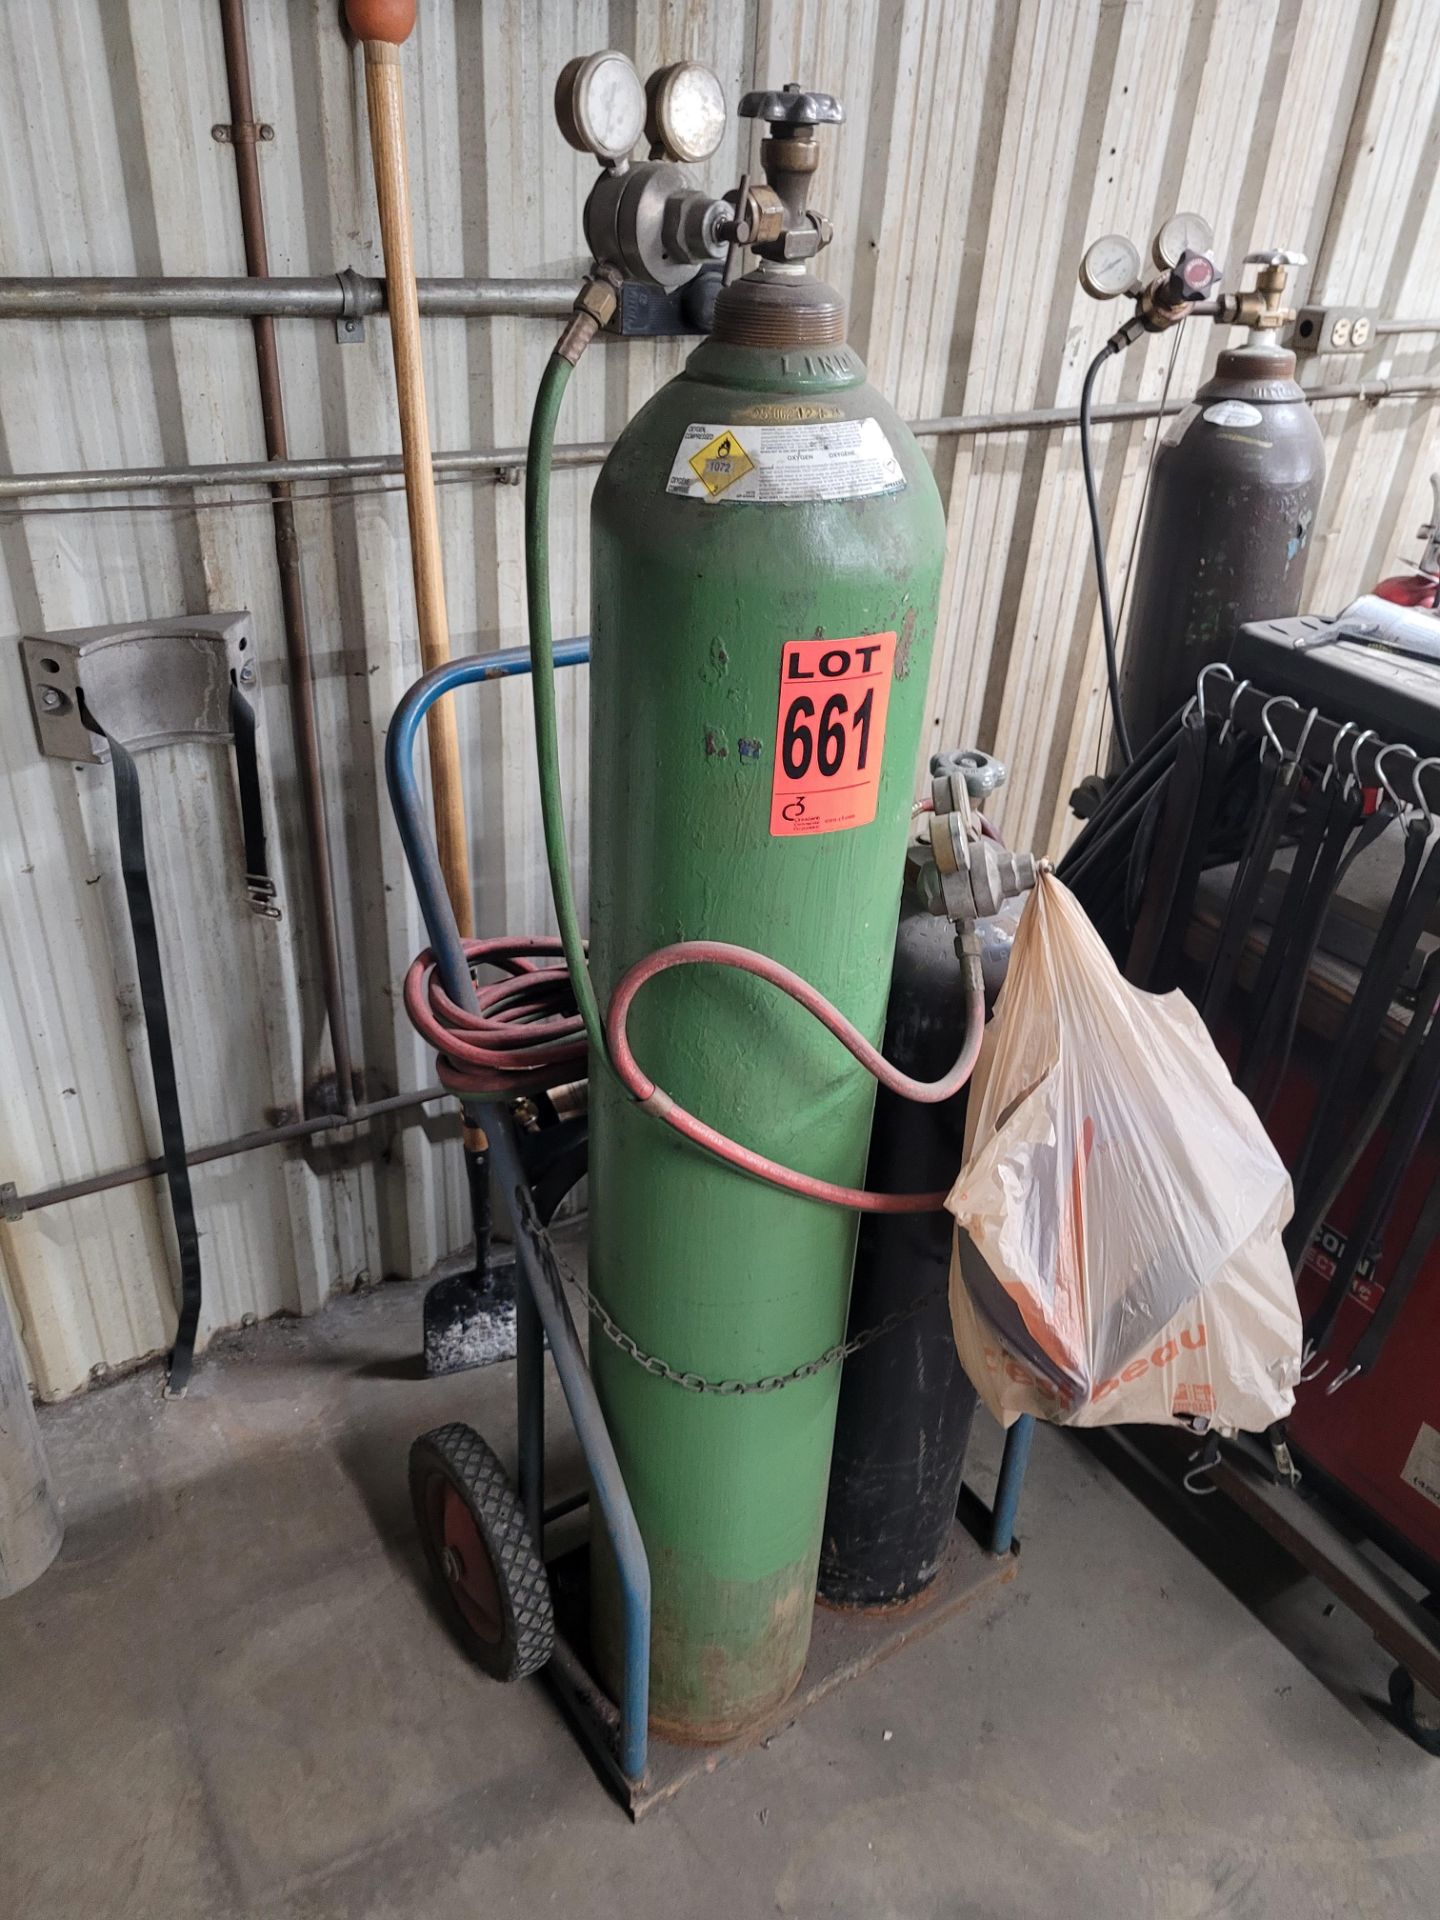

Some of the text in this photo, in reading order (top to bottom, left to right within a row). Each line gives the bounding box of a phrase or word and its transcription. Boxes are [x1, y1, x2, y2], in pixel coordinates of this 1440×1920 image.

[709, 461, 731, 473] 1072
[788, 645, 881, 680] LOT
[782, 688, 874, 780] 661
